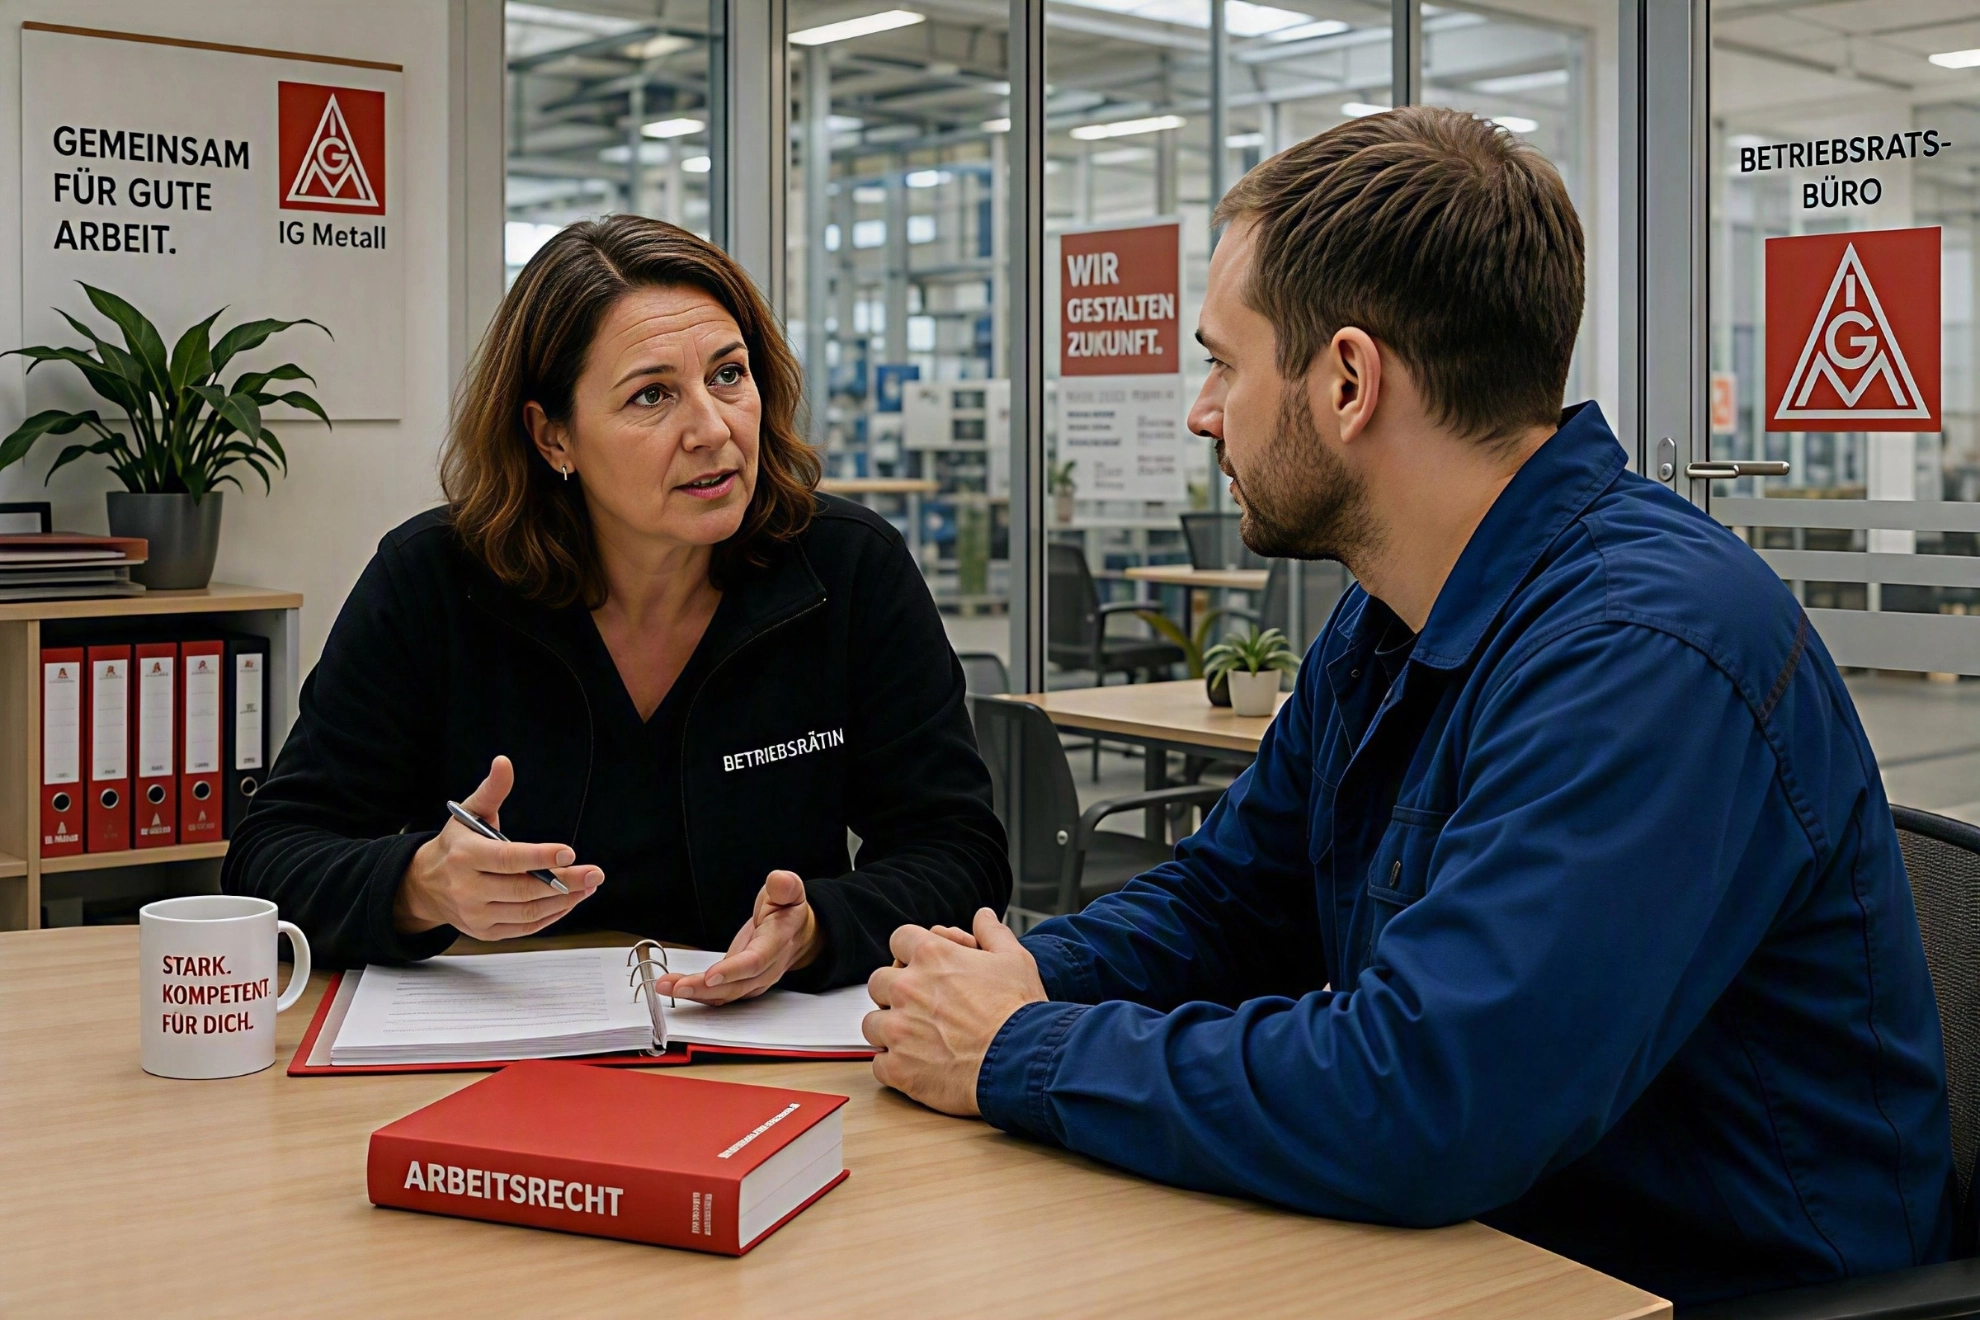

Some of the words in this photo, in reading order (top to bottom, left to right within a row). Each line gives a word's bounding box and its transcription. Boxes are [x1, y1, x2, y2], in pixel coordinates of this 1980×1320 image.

[53, 125, 249, 169] GEMEINSAM
[1740, 129, 1952, 172] BETRIEBSRATS-
[54, 167, 117, 206] FÜR
[128, 177, 212, 211] GUTE
[1803, 174, 1882, 209] BÜRO
[53, 219, 177, 255] ARBEIT.
[279, 220, 305, 245] IG
[313, 222, 386, 249] Metall
[1067, 252, 1120, 288] WIR
[1067, 293, 1175, 323] GESTALTEN
[1067, 328, 1163, 357] ZUKUNFT.
[723, 728, 845, 772] BETRIEBSRÄTIN
[162, 955, 232, 977] STARK.
[203, 1012, 254, 1035] DICH.
[404, 1160, 624, 1217] ARBEITSRECHT
